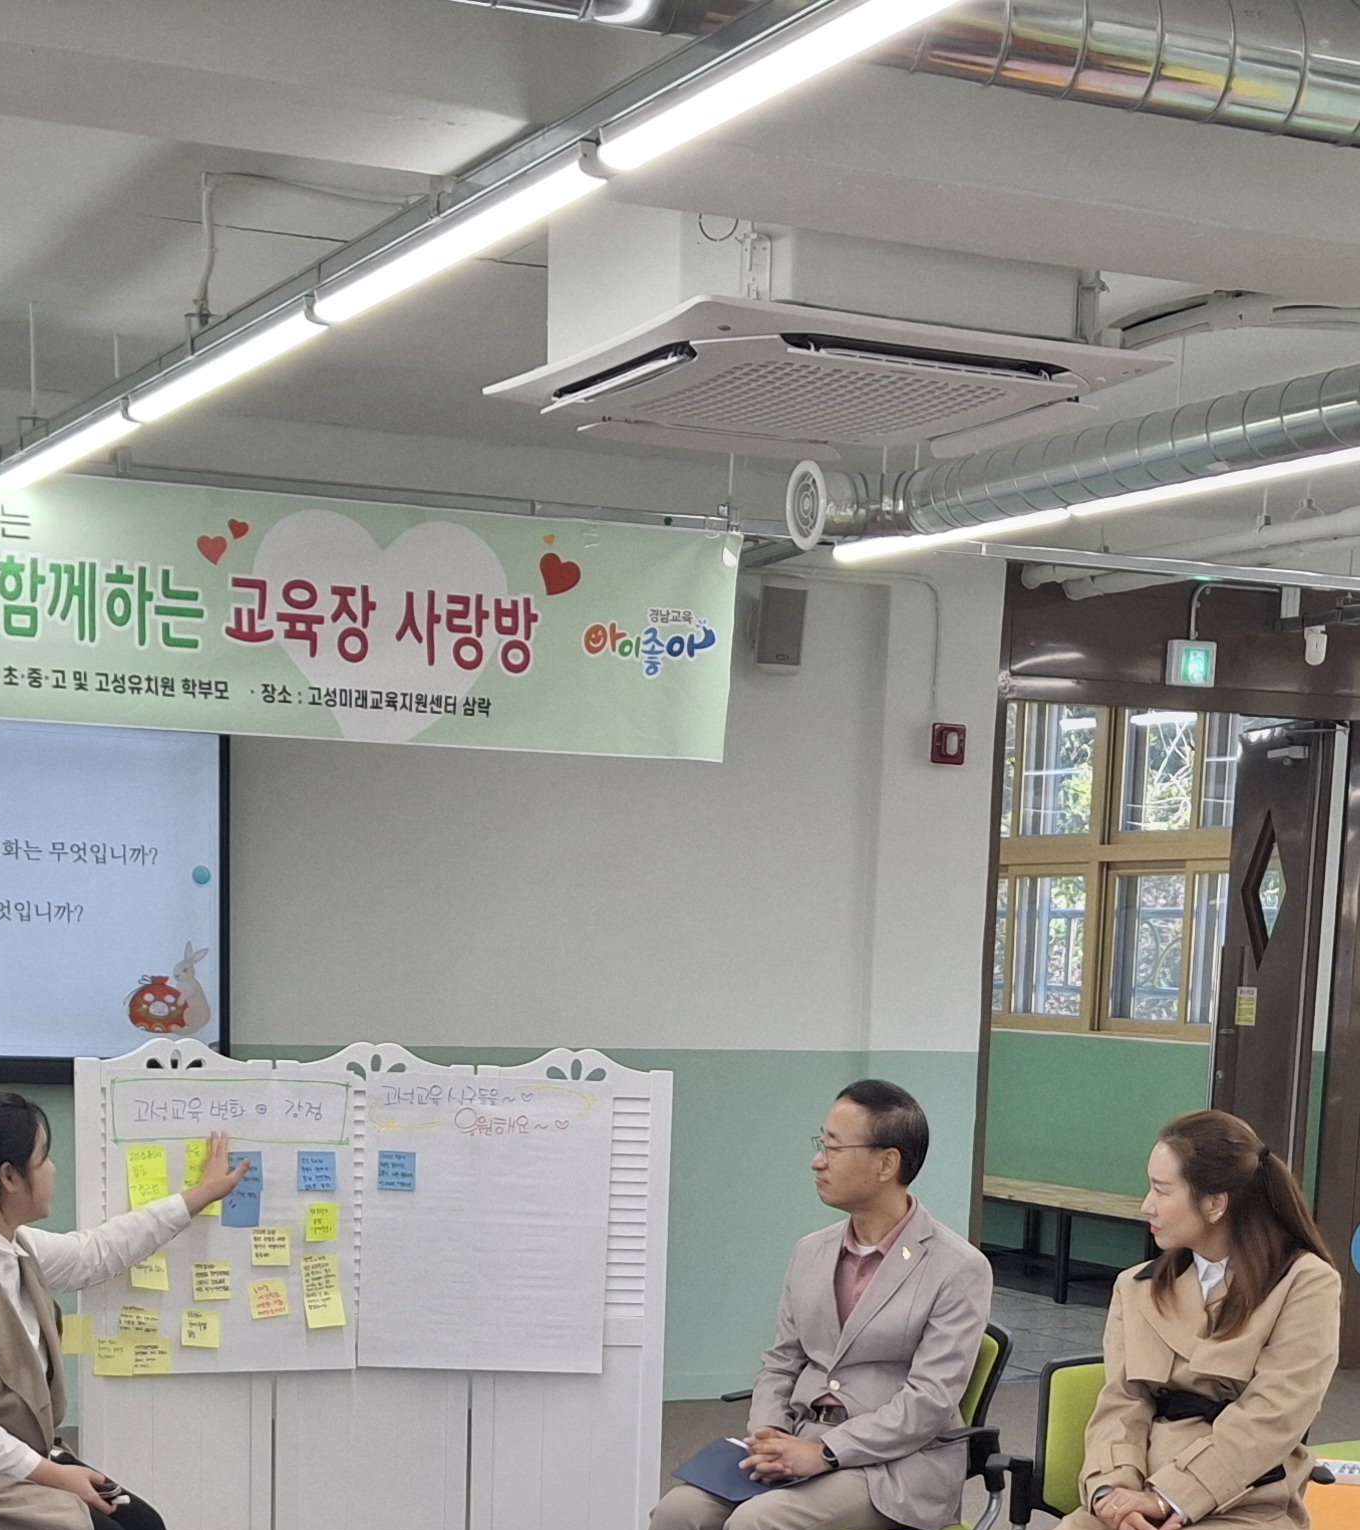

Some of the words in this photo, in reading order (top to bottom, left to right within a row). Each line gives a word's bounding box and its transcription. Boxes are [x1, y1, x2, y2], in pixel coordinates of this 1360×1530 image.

[224, 576, 377, 663] 교육장
[394, 588, 539, 674] 사랑방
[648, 607, 694, 625] 경남교육
[583, 621, 716, 676] 아이좋아
[72, 669, 89, 692] 및
[94, 671, 176, 698] 고성유치원
[181, 677, 230, 700] 학부모
[307, 686, 458, 716] 고성미래교육지원센터
[462, 695, 493, 718] 삼락
[48, 841, 159, 867] 무엇입니까?
[380, 1083, 443, 1107] 고성교육
[133, 1096, 205, 1123] 고성교육
[209, 1098, 246, 1121] 변화
